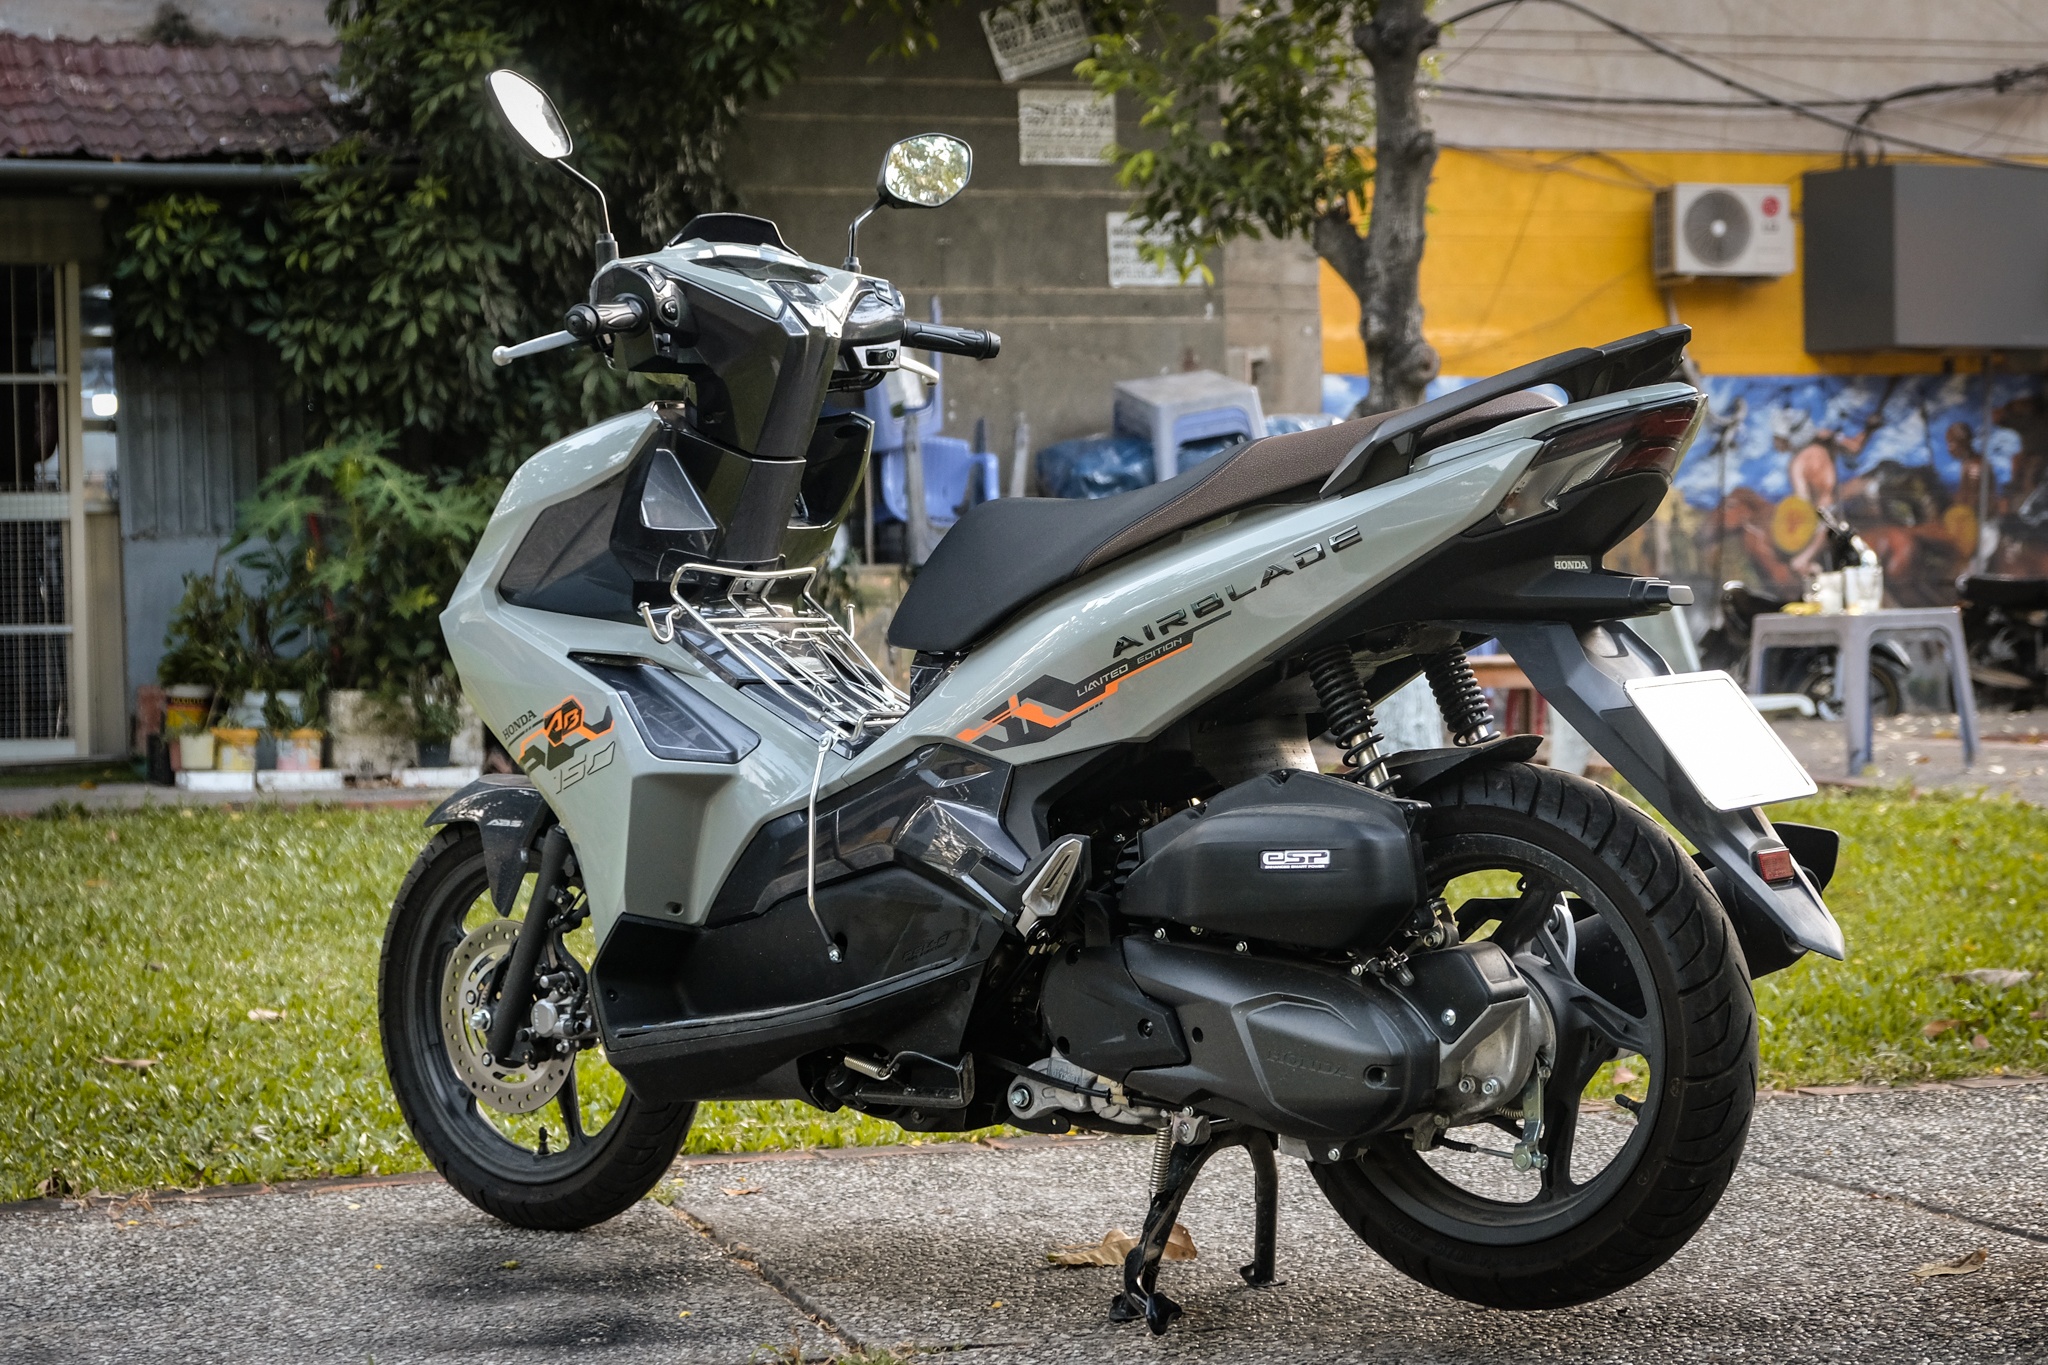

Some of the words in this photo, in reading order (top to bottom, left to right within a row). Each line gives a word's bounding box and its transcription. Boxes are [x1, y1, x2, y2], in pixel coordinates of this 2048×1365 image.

[1554, 560, 1589, 570] HONDA
[1112, 524, 1363, 658] AIRBLADE
[1076, 663, 1130, 698] LIMITED
[1136, 637, 1183, 664] EDITION
[502, 709, 537, 740] HONDA
[553, 740, 616, 795] 150
[486, 818, 523, 828] ABS
